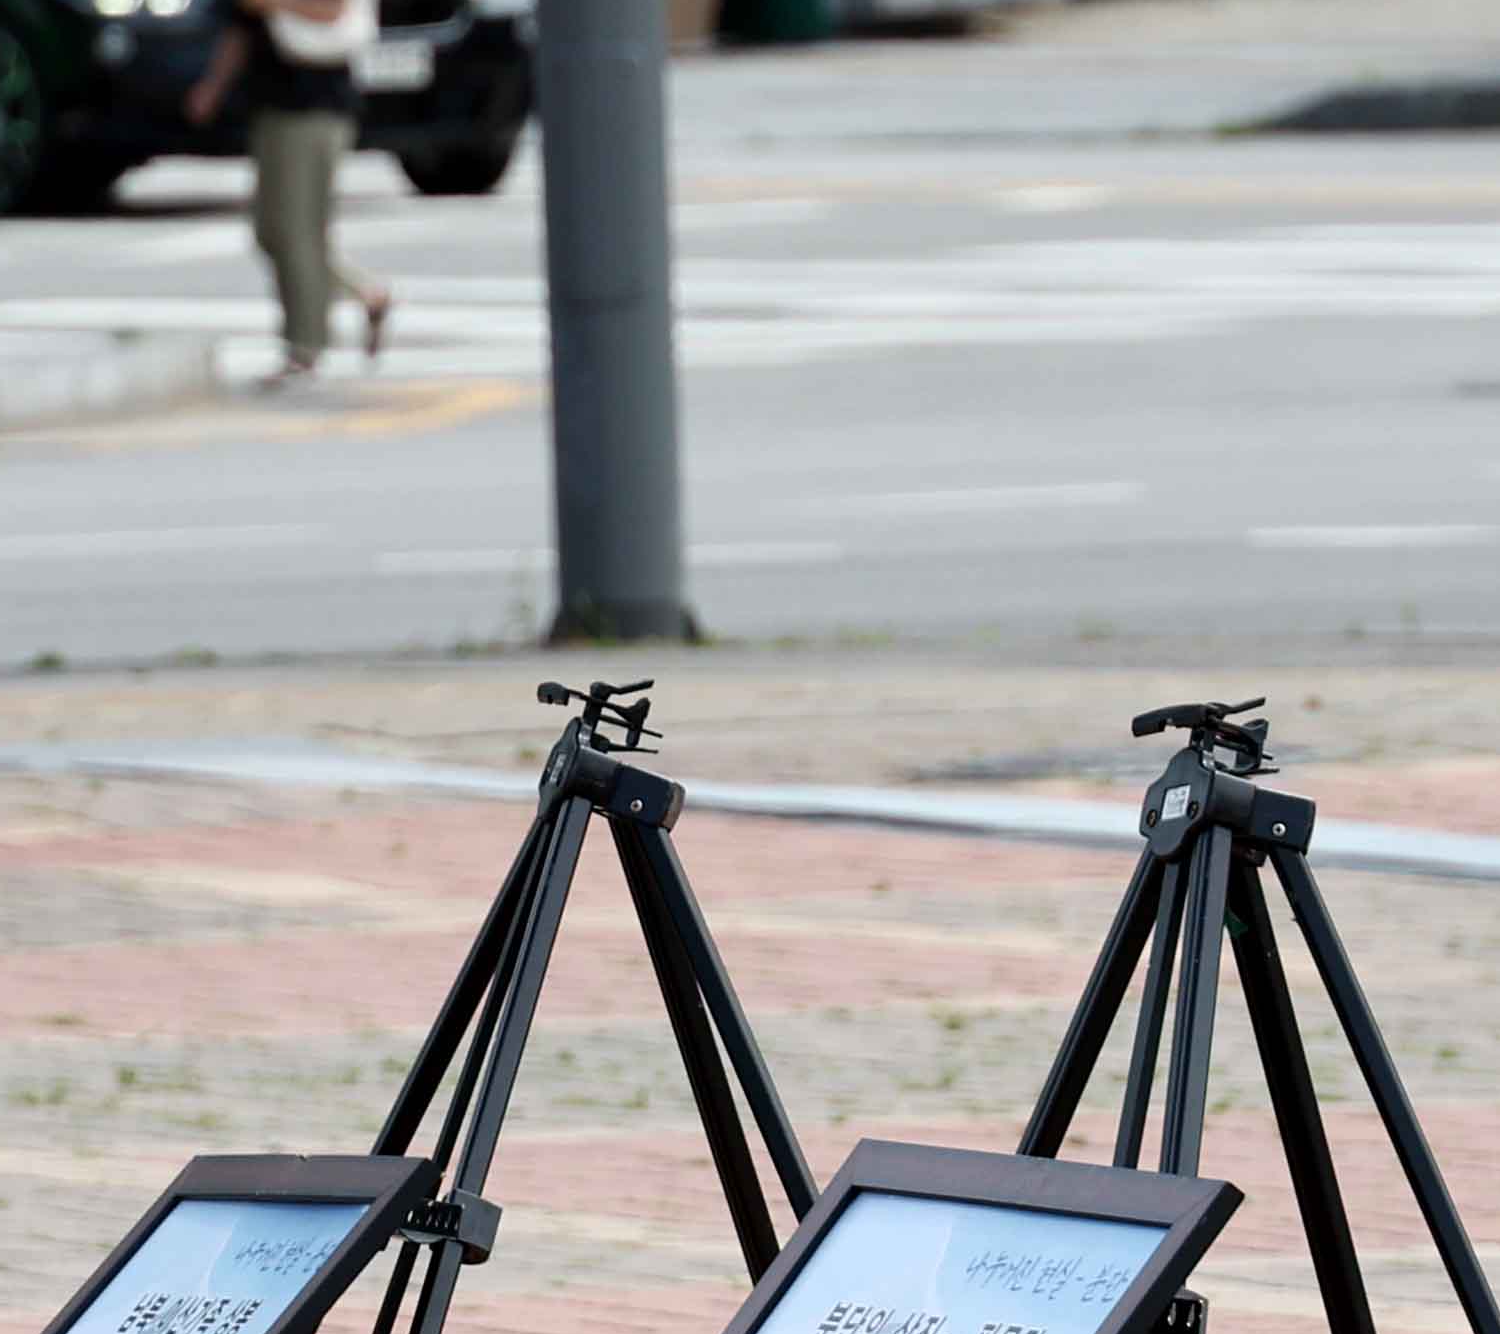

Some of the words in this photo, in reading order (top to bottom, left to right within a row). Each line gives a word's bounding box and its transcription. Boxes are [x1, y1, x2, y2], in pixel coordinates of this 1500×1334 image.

[966, 1250, 1042, 1292] 나누어진
[1031, 1256, 1083, 1301] 현실
[1080, 1265, 1130, 1304] 분단
[117, 1296, 169, 1334] 남북
